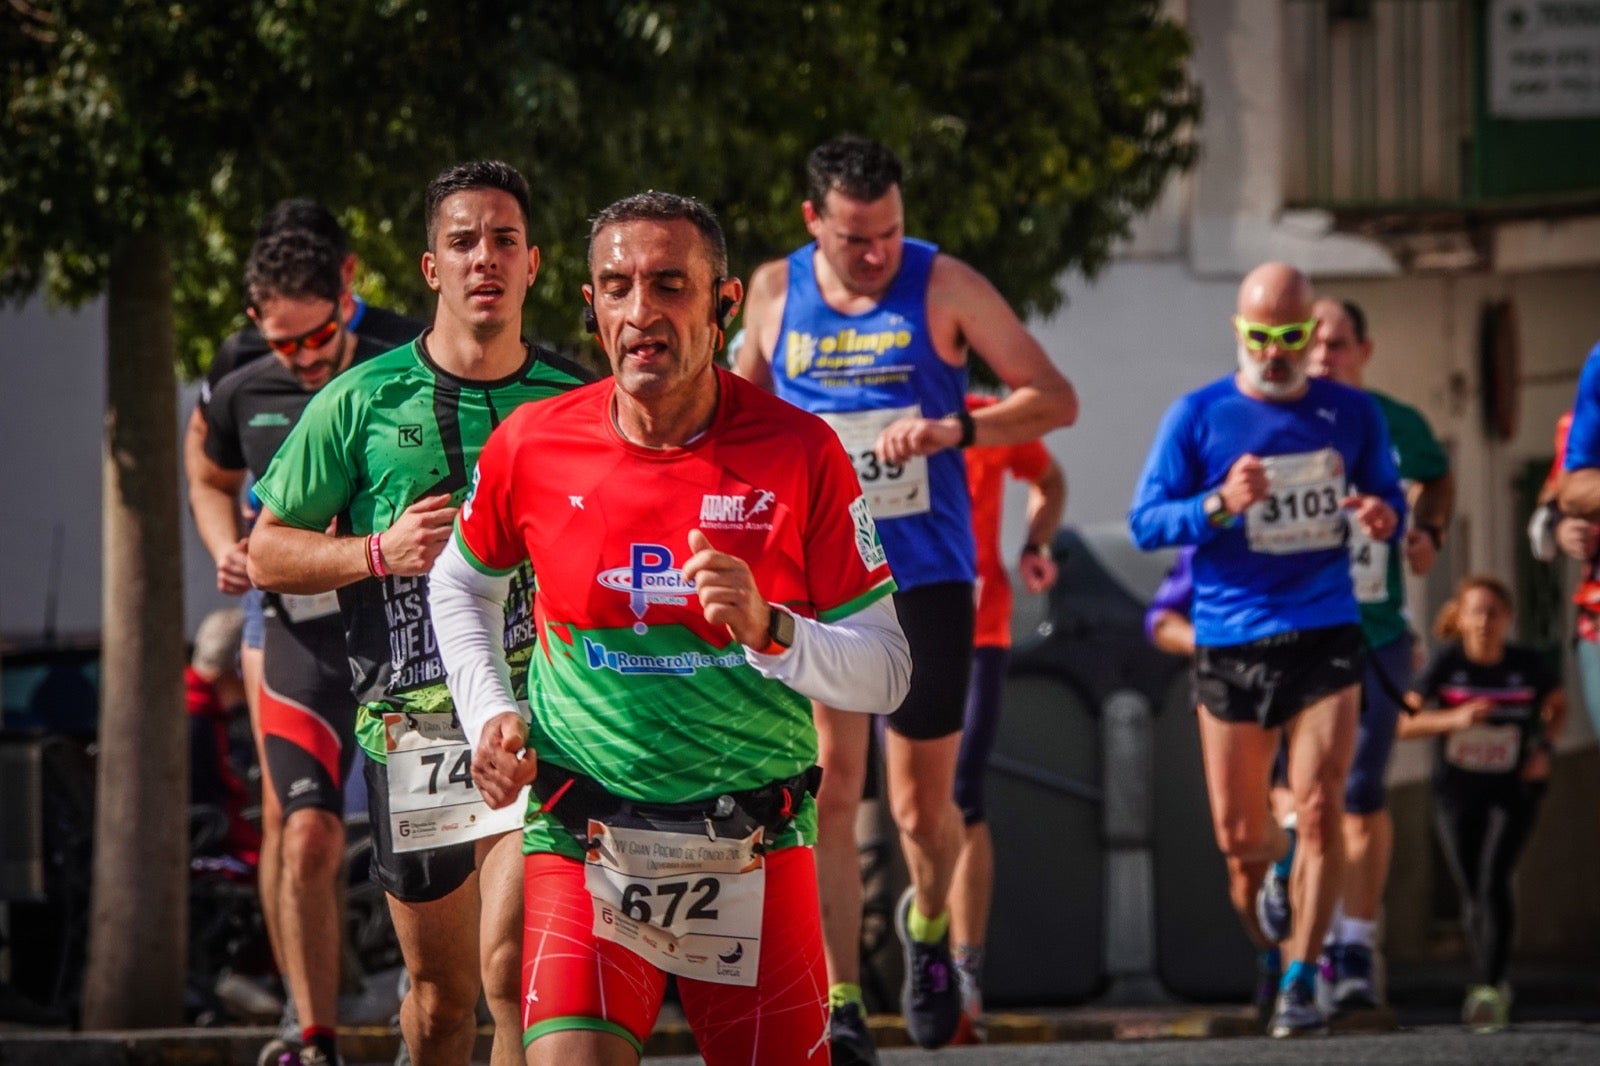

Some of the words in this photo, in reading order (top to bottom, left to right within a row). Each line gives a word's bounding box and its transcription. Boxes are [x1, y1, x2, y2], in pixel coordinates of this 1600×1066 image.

[819, 328, 912, 355] olimpo
[848, 450, 906, 482] 39
[700, 494, 747, 522] ATARFE
[1262, 486, 1338, 523] 3103
[621, 877, 721, 928] 672
